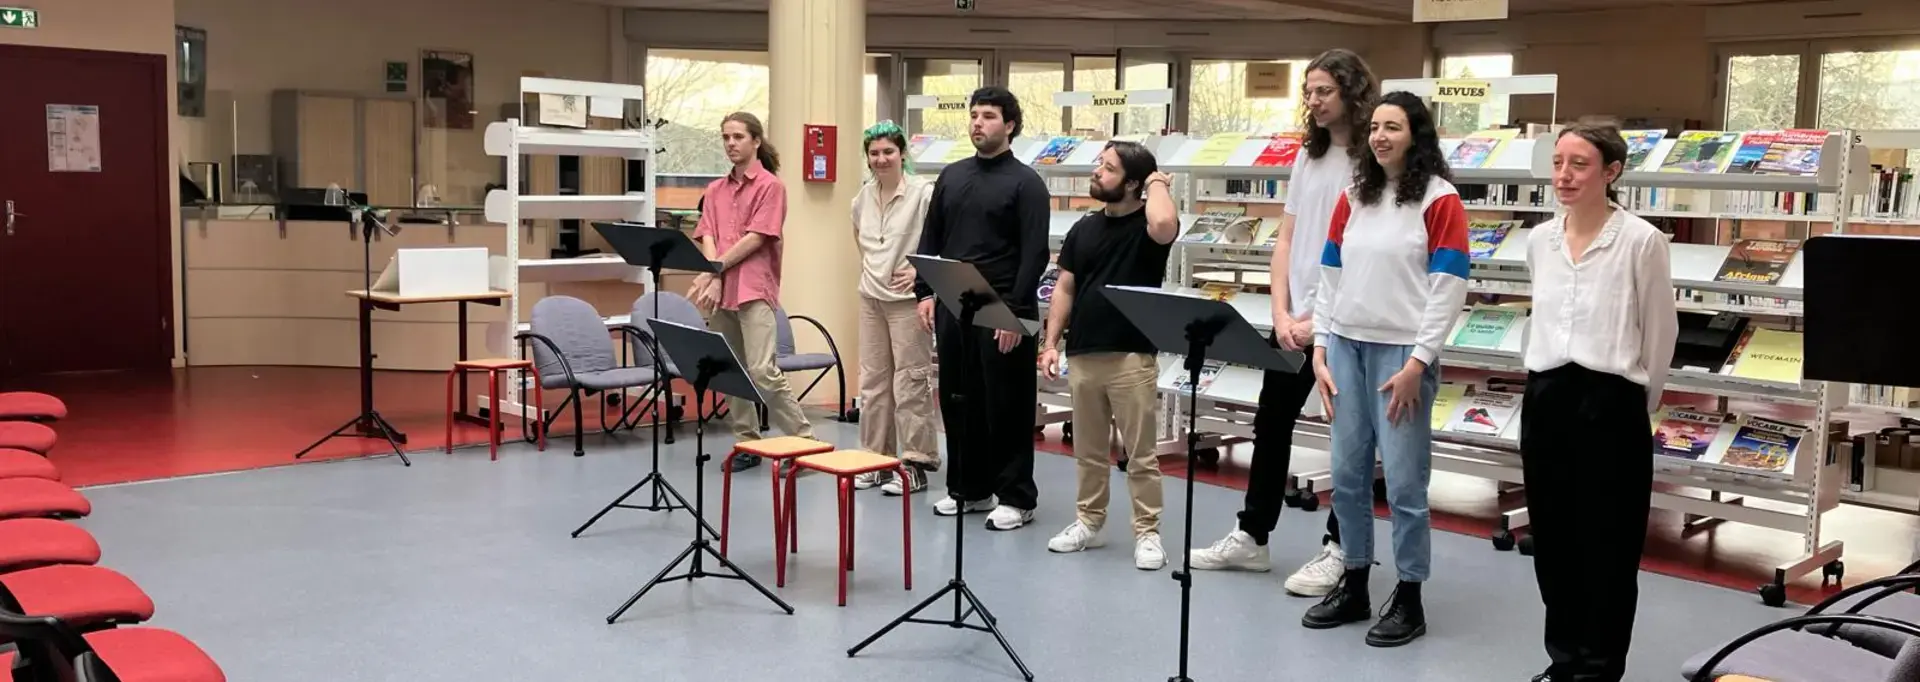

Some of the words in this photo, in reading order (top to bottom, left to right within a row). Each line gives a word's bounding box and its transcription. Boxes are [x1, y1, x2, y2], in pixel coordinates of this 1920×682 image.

[1438, 87, 1485, 97] REVUES
[938, 102, 966, 110] REVUES
[1093, 97, 1127, 106] REVUES
[1668, 411, 1705, 421] VOCABLE
[1746, 420, 1786, 432] VOCABLE
